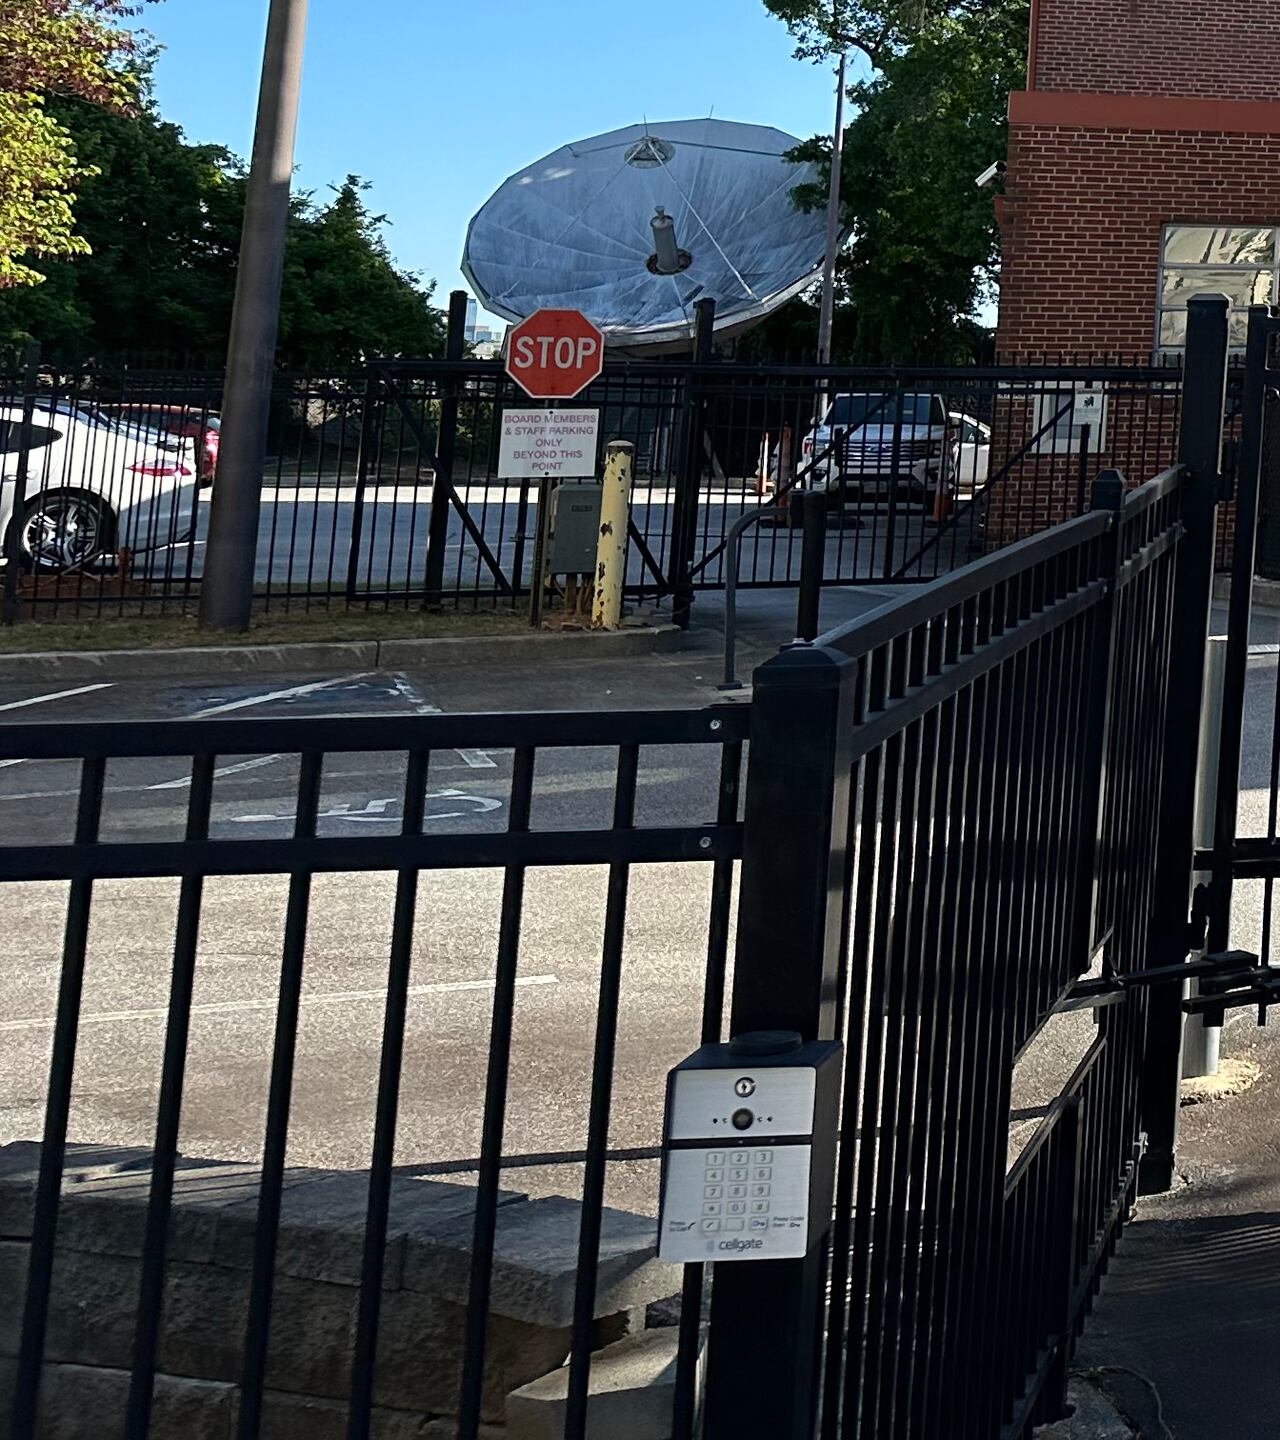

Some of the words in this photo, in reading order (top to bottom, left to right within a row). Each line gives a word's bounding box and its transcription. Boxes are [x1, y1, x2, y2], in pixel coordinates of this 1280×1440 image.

[514, 336, 597, 369] STOP
[504, 414, 541, 423] BOARD
[544, 414, 596, 423] MEMBERS
[505, 427, 511, 435] &
[514, 427, 547, 435] STAFF
[549, 426, 593, 435] PARKING
[535, 439, 563, 447] ONLY
[513, 450, 557, 459] BEYOND
[560, 449, 583, 458] THIS
[531, 462, 563, 470] POINT
[719, 1238, 764, 1252] cellgate
